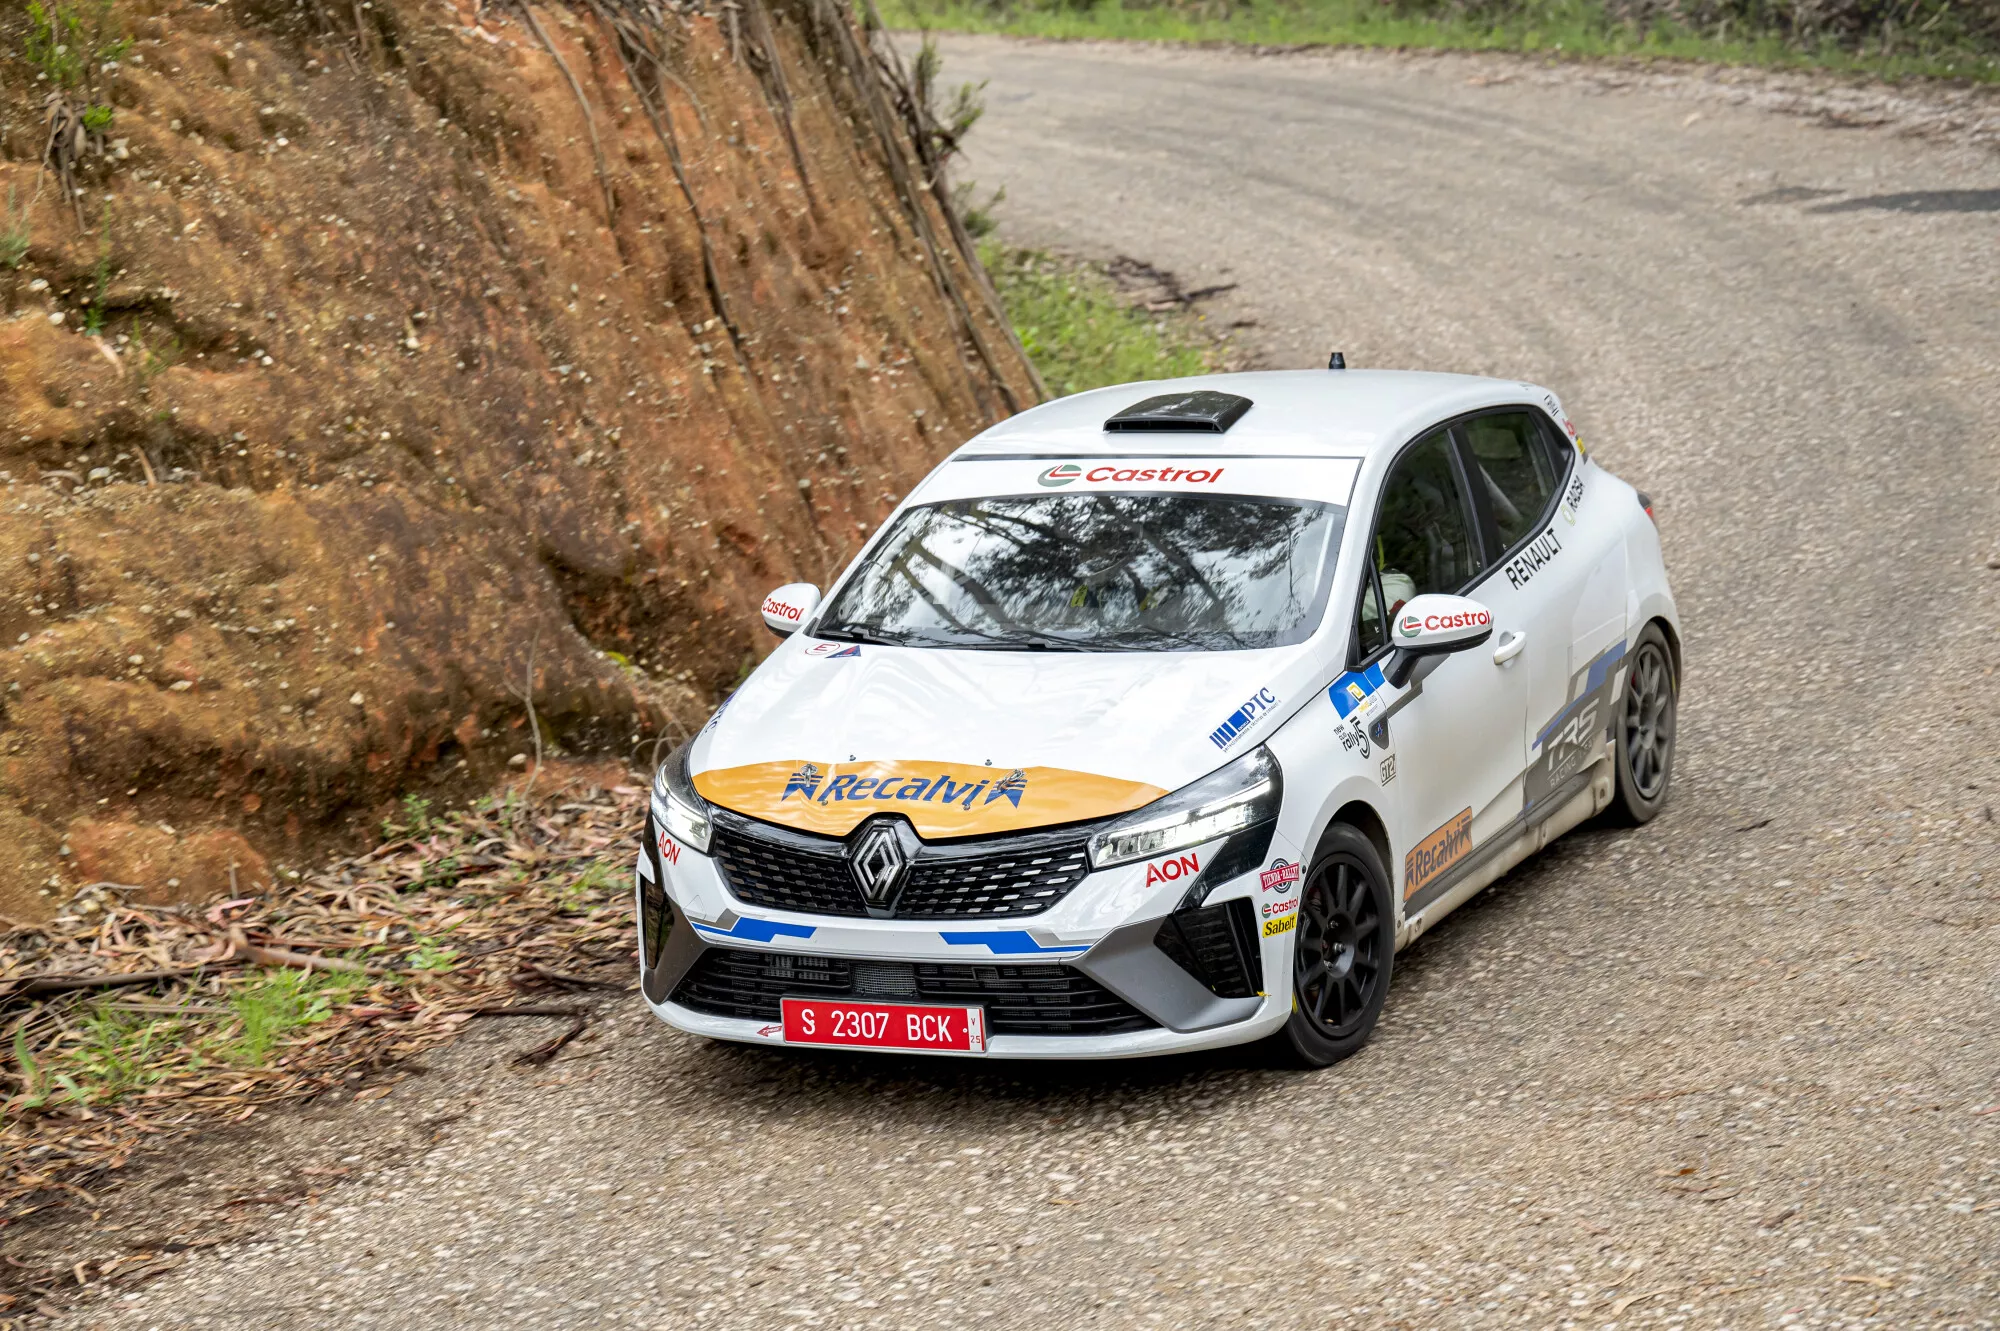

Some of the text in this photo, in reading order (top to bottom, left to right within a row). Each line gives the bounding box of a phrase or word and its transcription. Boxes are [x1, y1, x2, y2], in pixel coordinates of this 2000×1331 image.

[1085, 466, 1224, 483] Castrol
[1505, 527, 1562, 590] RENAULT
[762, 598, 805, 621] Castrol
[1425, 610, 1490, 631] Castrol
[1241, 686, 1276, 720] PTC
[1549, 756, 1577, 788] RACING
[817, 774, 990, 806] Recalvi
[658, 830, 681, 866] AON
[1415, 822, 1461, 887] Recalvi
[1146, 852, 1199, 888] AON
[1272, 896, 1299, 915] Castrol
[1265, 915, 1295, 936] Sabelt
[801, 1008, 953, 1042] S 2307 BCK
[970, 1017, 976, 1026] V
[970, 1034, 981, 1044] 25
